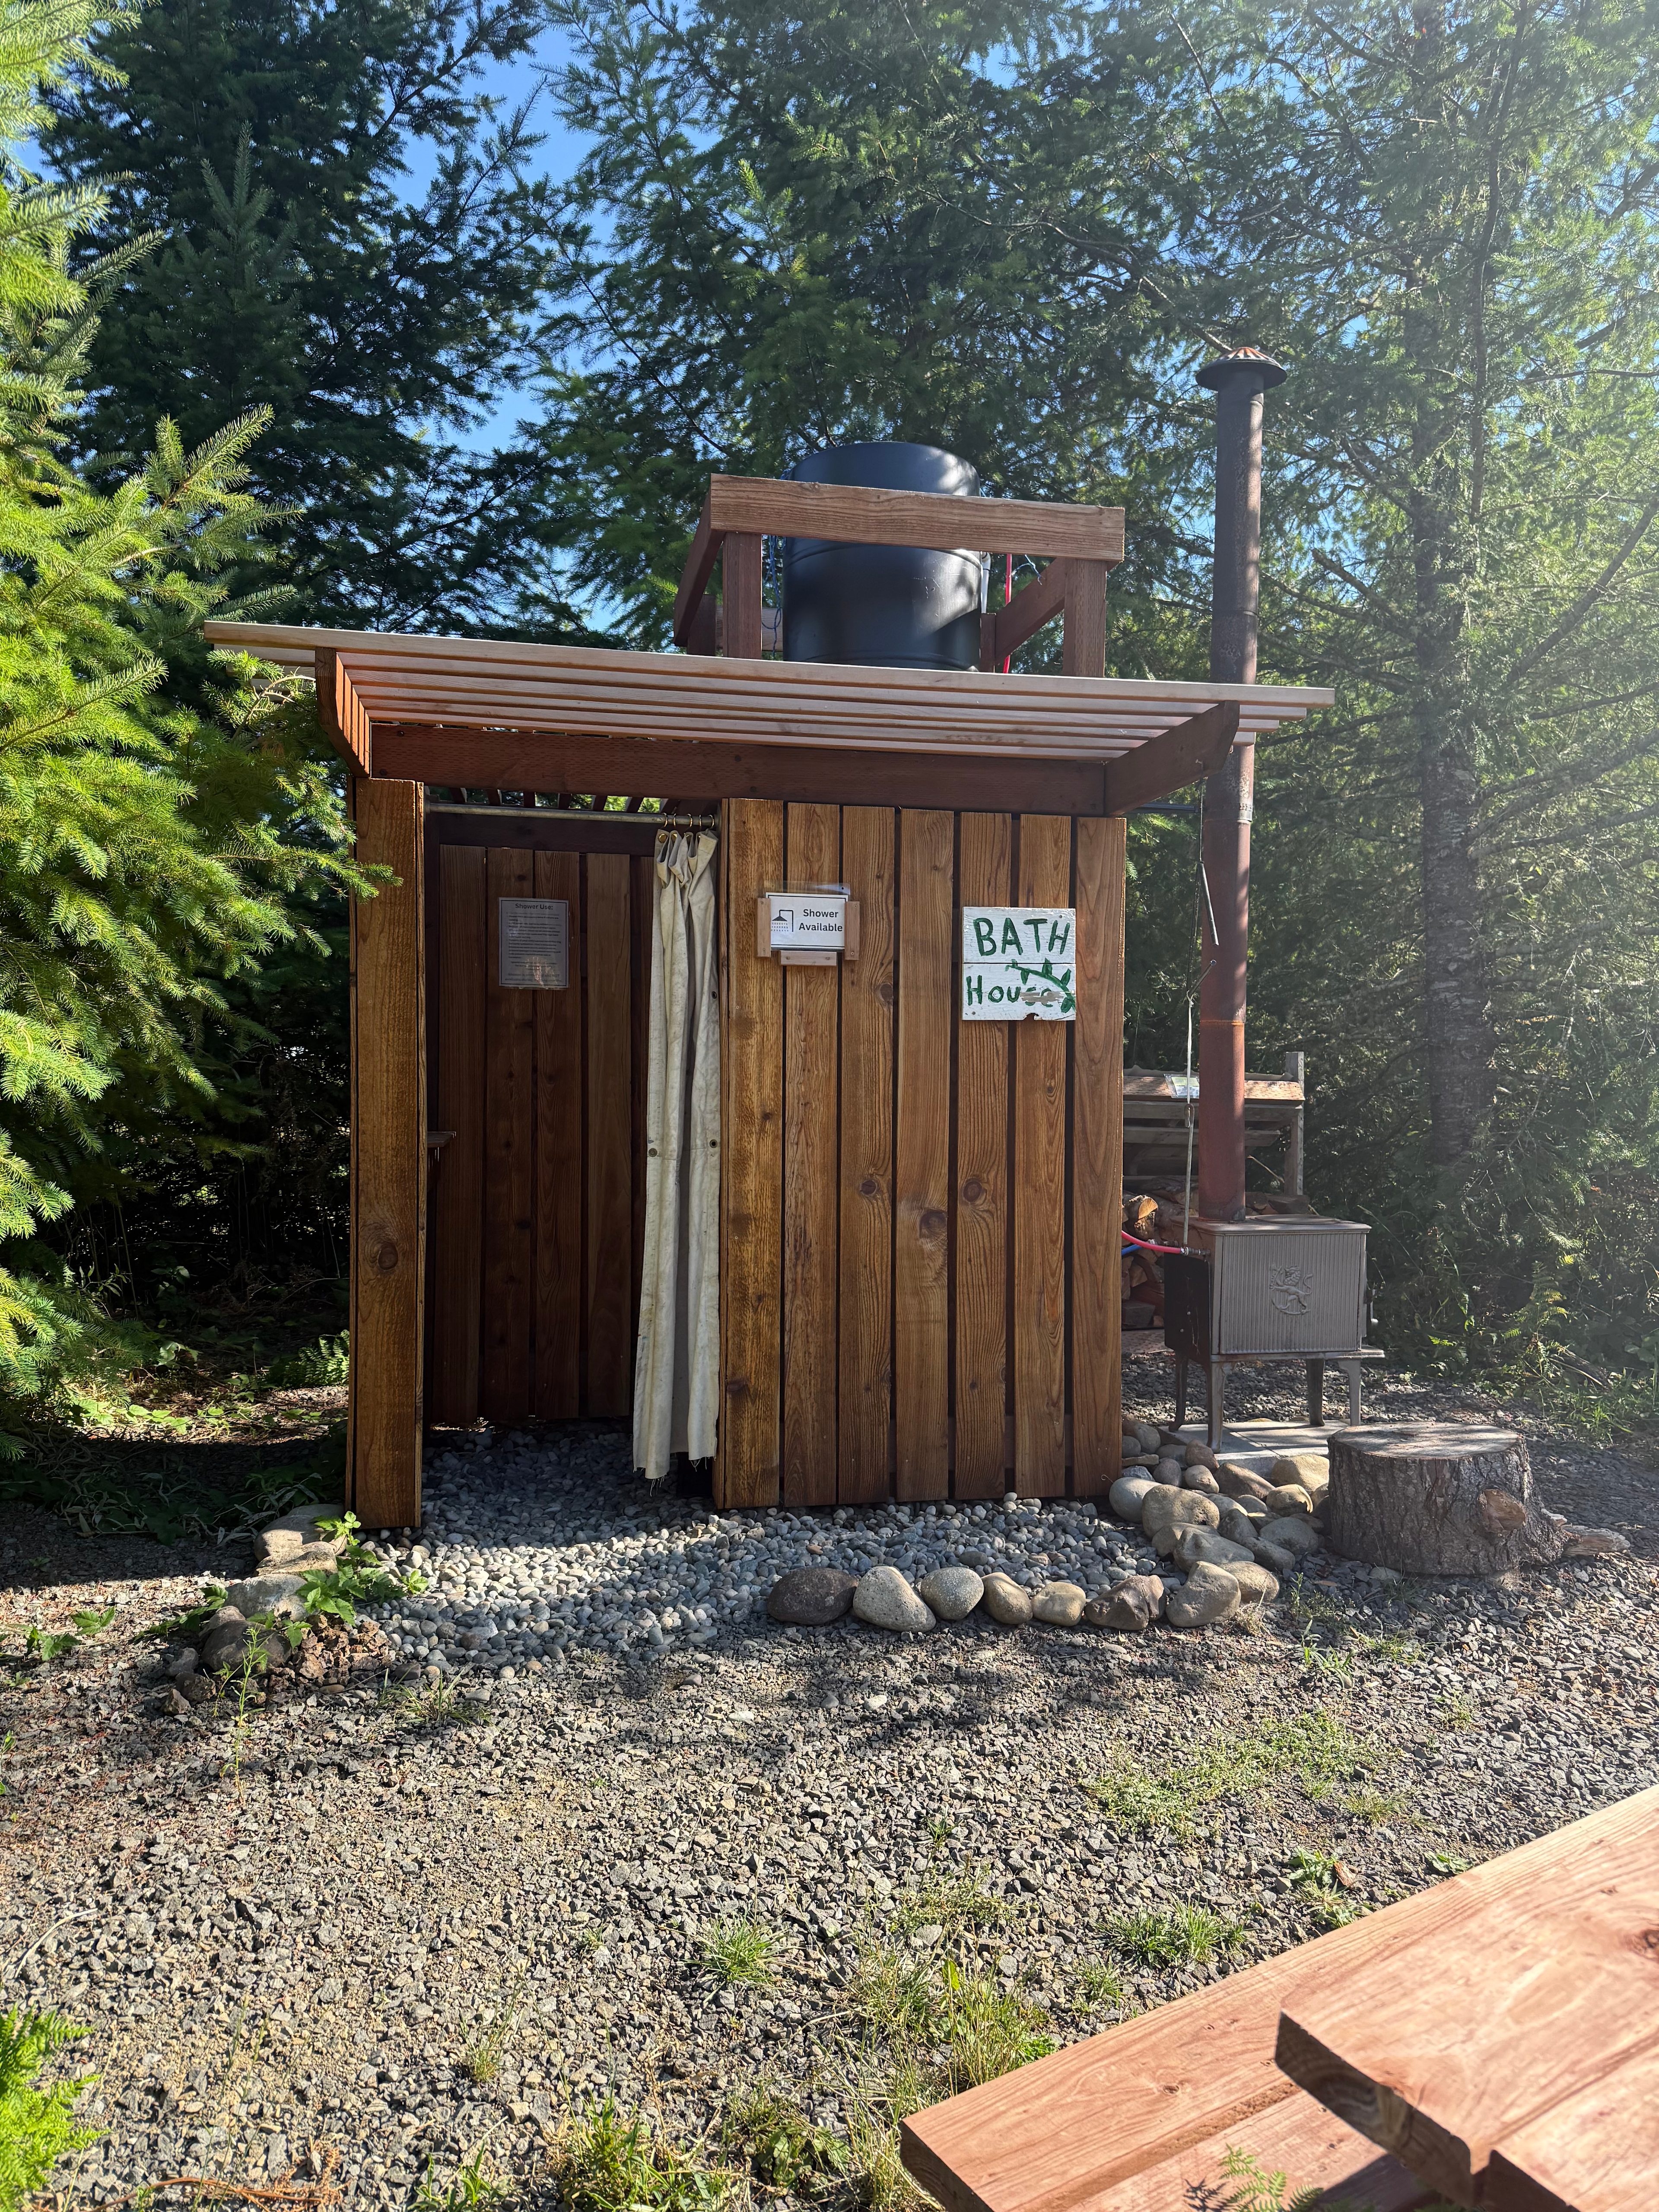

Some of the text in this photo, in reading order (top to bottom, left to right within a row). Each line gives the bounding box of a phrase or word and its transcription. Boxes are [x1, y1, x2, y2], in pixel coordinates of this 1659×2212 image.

[803, 909, 839, 918] Shower
[799, 923, 842, 931] Available
[973, 918, 1070, 956] BATH
